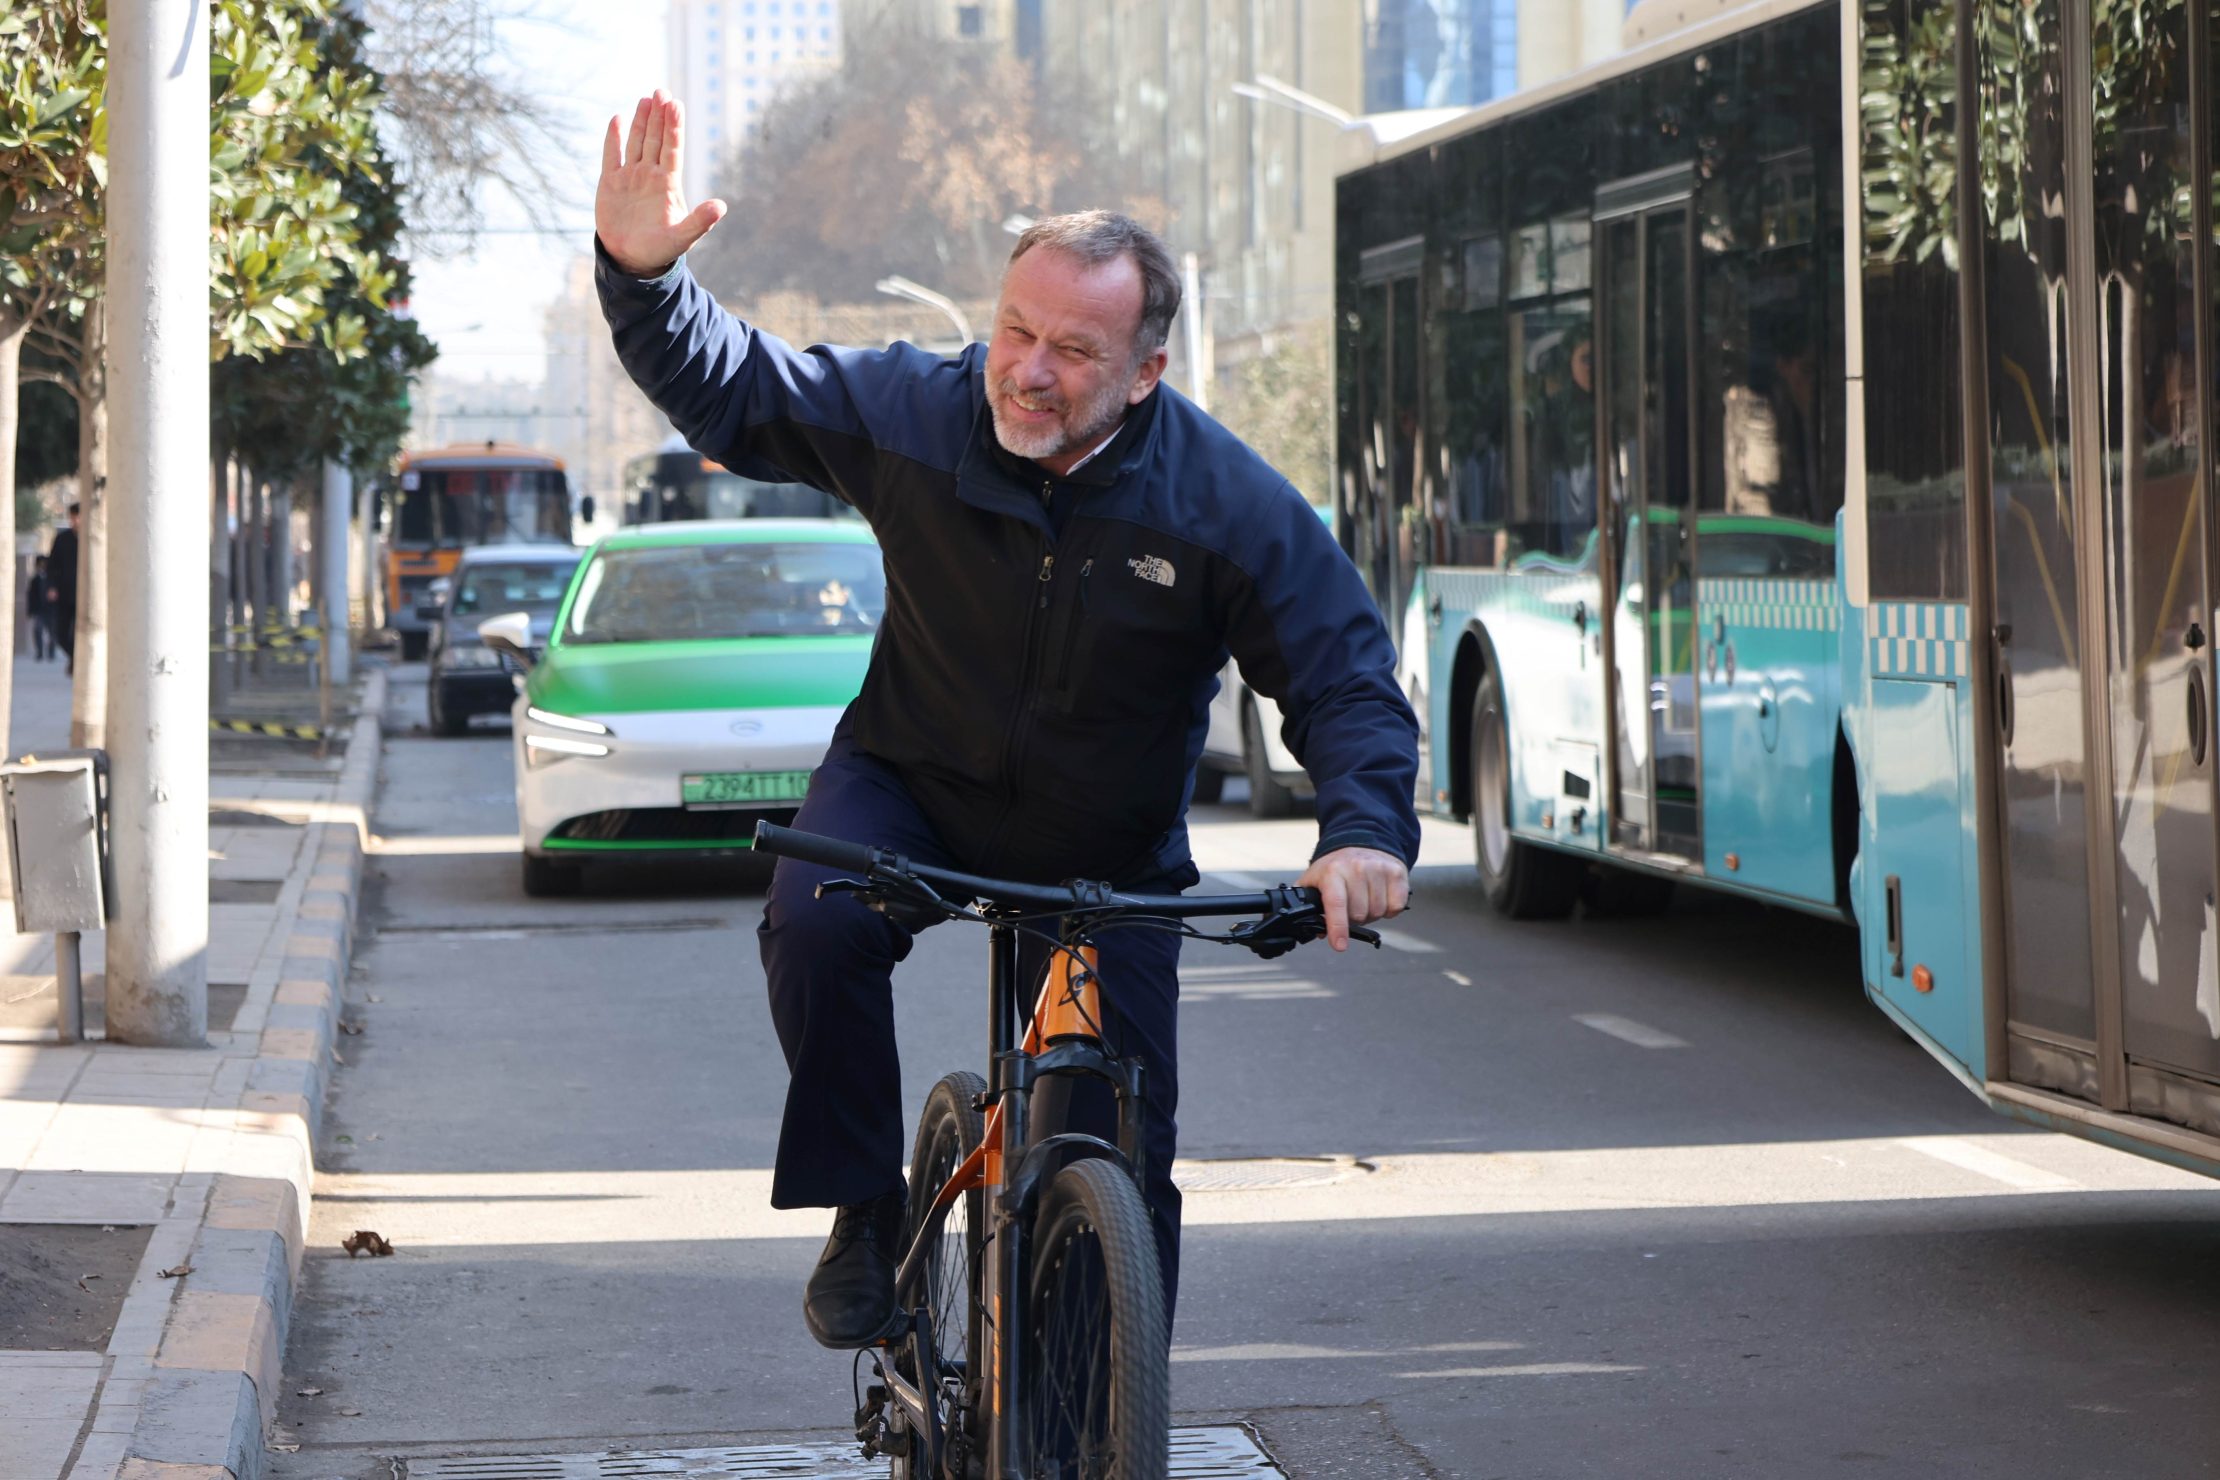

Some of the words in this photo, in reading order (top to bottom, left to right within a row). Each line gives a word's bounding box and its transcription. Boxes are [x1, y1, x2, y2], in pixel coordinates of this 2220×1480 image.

[1127, 558, 1160, 575] NORTH
[1144, 554, 1163, 567] THE
[1134, 568, 1157, 582] FACE
